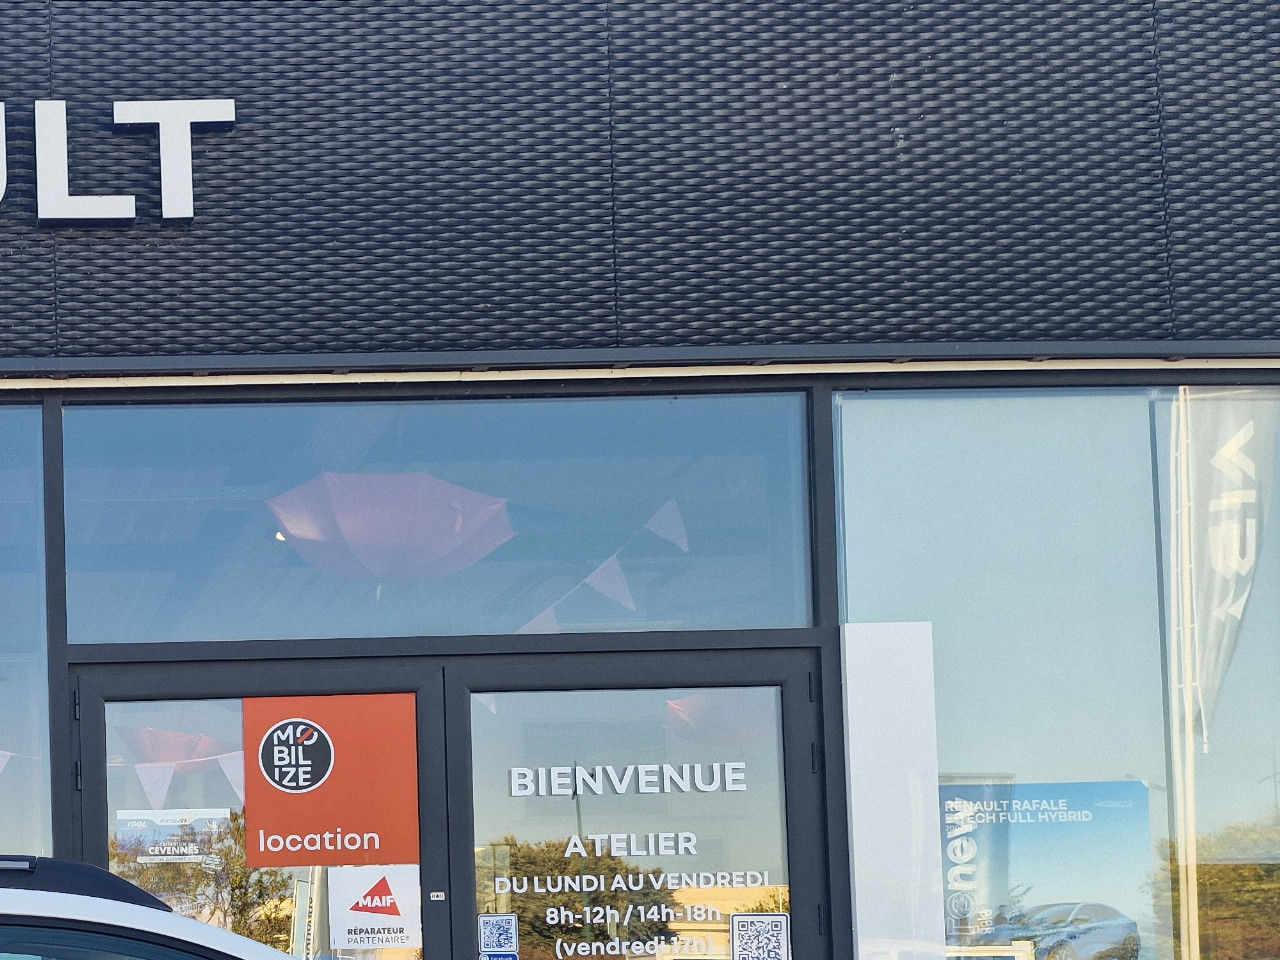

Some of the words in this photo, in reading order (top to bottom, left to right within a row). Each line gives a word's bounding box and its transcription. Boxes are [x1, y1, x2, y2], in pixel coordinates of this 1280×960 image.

[510, 762, 747, 797] BIENVENUE
[1012, 799, 1067, 811] RAFALE
[945, 812, 996, 824] EECH
[999, 812, 1035, 823] FULL
[1038, 810, 1092, 822] HYBRID
[148, 844, 199, 855] CÉVENNES
[258, 829, 380, 852] location
[564, 831, 698, 858] ATELIER
[494, 876, 528, 893] DU
[533, 874, 605, 893] LUNDI
[611, 873, 644, 891] AU
[648, 870, 769, 889] VENDREDI
[359, 895, 394, 908] MAIF
[347, 926, 404, 936] RÉPARATEUR
[554, 936, 666, 958] (vendredi
